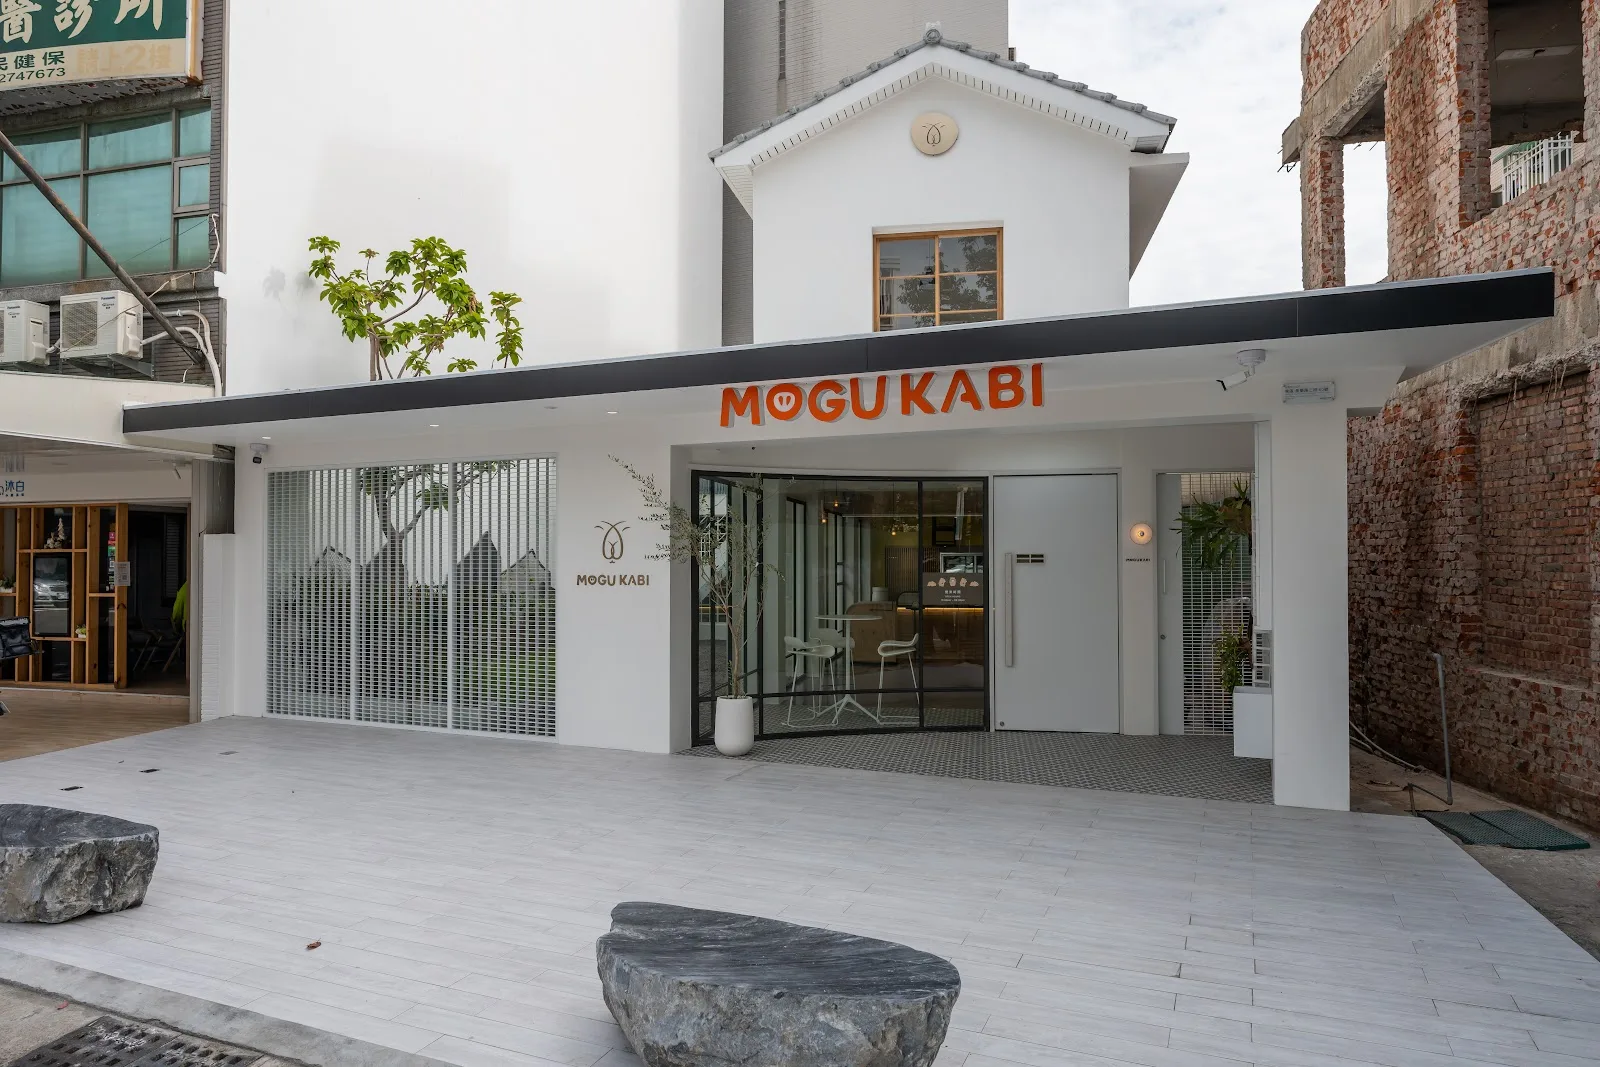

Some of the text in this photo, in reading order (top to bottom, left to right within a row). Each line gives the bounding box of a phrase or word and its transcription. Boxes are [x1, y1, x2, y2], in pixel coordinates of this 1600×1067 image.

[0, 67, 66, 82] 2747673
[720, 363, 1044, 428] MOGU KABI
[576, 574, 650, 586] MOGU KABI
